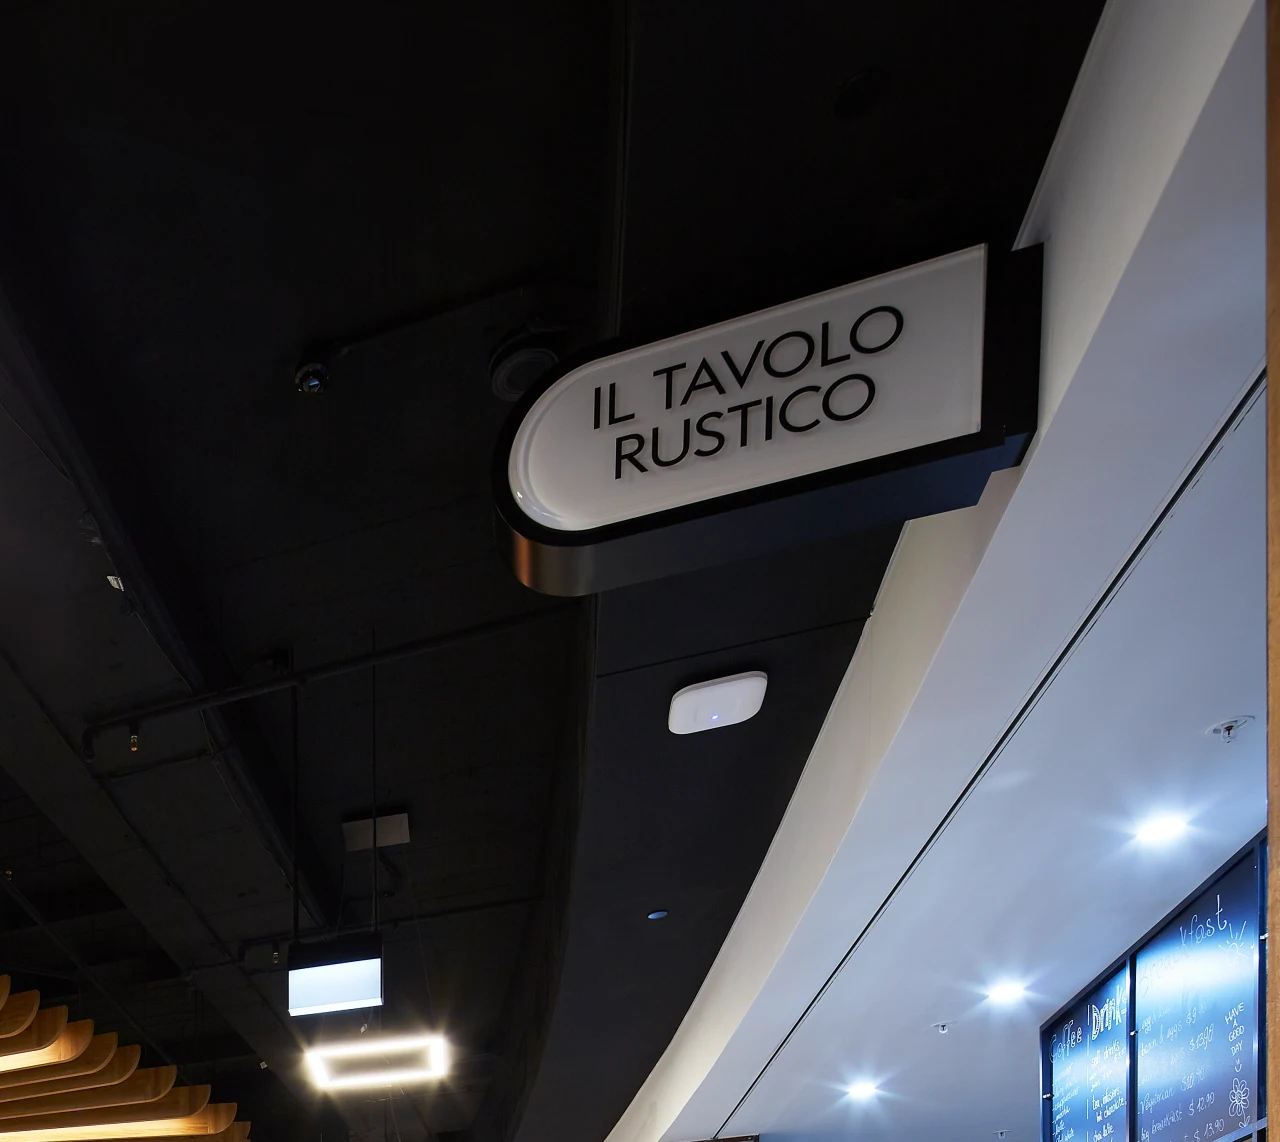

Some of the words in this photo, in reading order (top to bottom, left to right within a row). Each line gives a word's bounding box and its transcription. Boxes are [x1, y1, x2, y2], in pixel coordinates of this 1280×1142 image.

[593, 382, 635, 430] IL
[653, 305, 904, 410] TAVOLO
[615, 373, 876, 480] RUSTICO
[1224, 1002, 1245, 1025] HAVE
[1233, 1020, 1238, 1028] A
[1049, 1019, 1082, 1063] Coffee
[1228, 1025, 1245, 1042] GOOD
[1231, 1040, 1243, 1057] DAY
